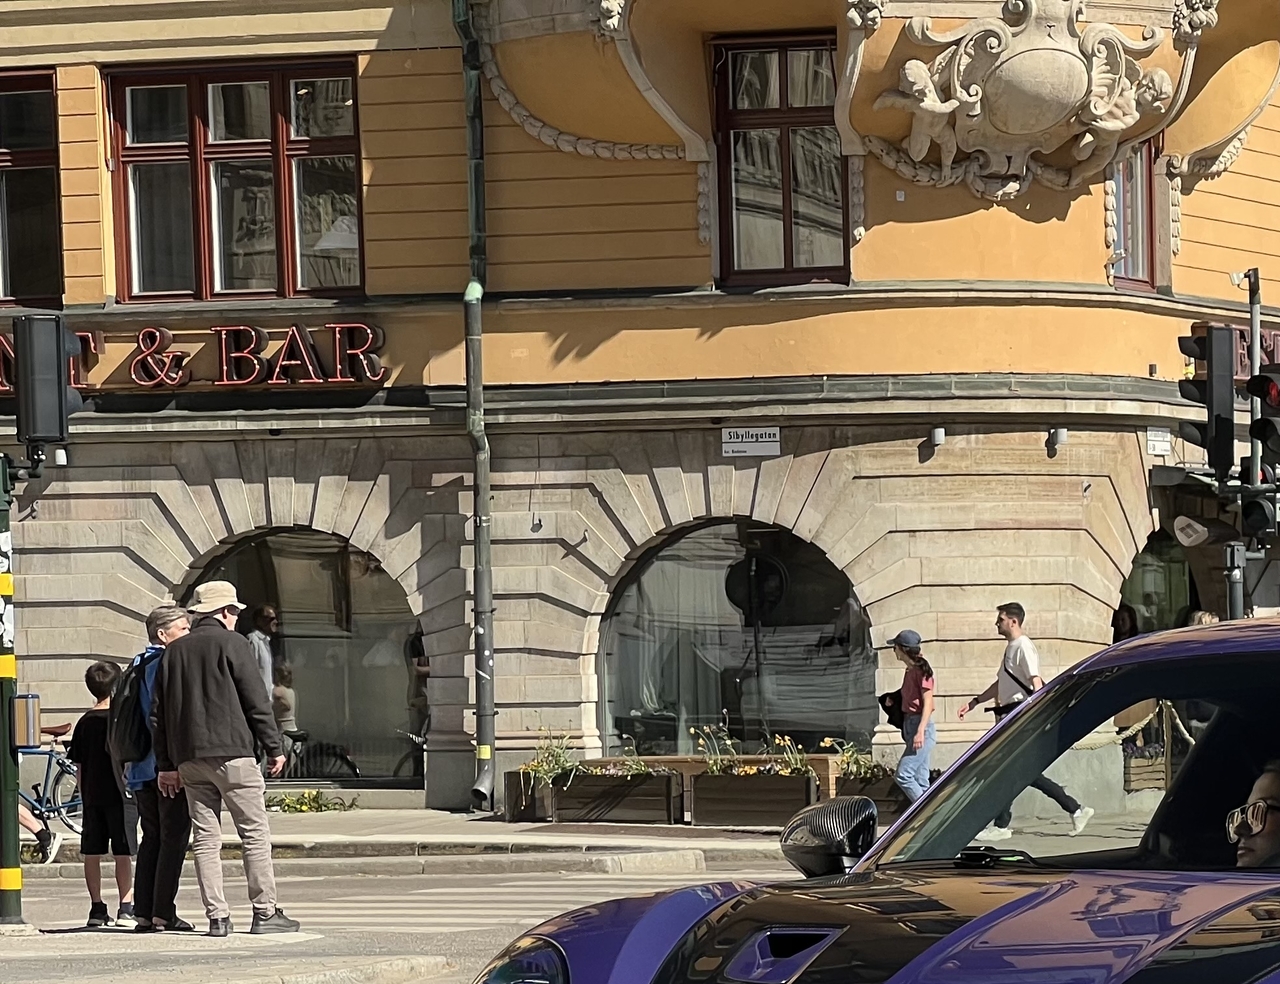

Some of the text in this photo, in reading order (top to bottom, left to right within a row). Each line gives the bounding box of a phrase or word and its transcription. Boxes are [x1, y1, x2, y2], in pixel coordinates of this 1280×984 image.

[130, 326, 188, 387] &
[210, 322, 391, 386] BAR
[728, 430, 777, 442] Sibyllegatan
